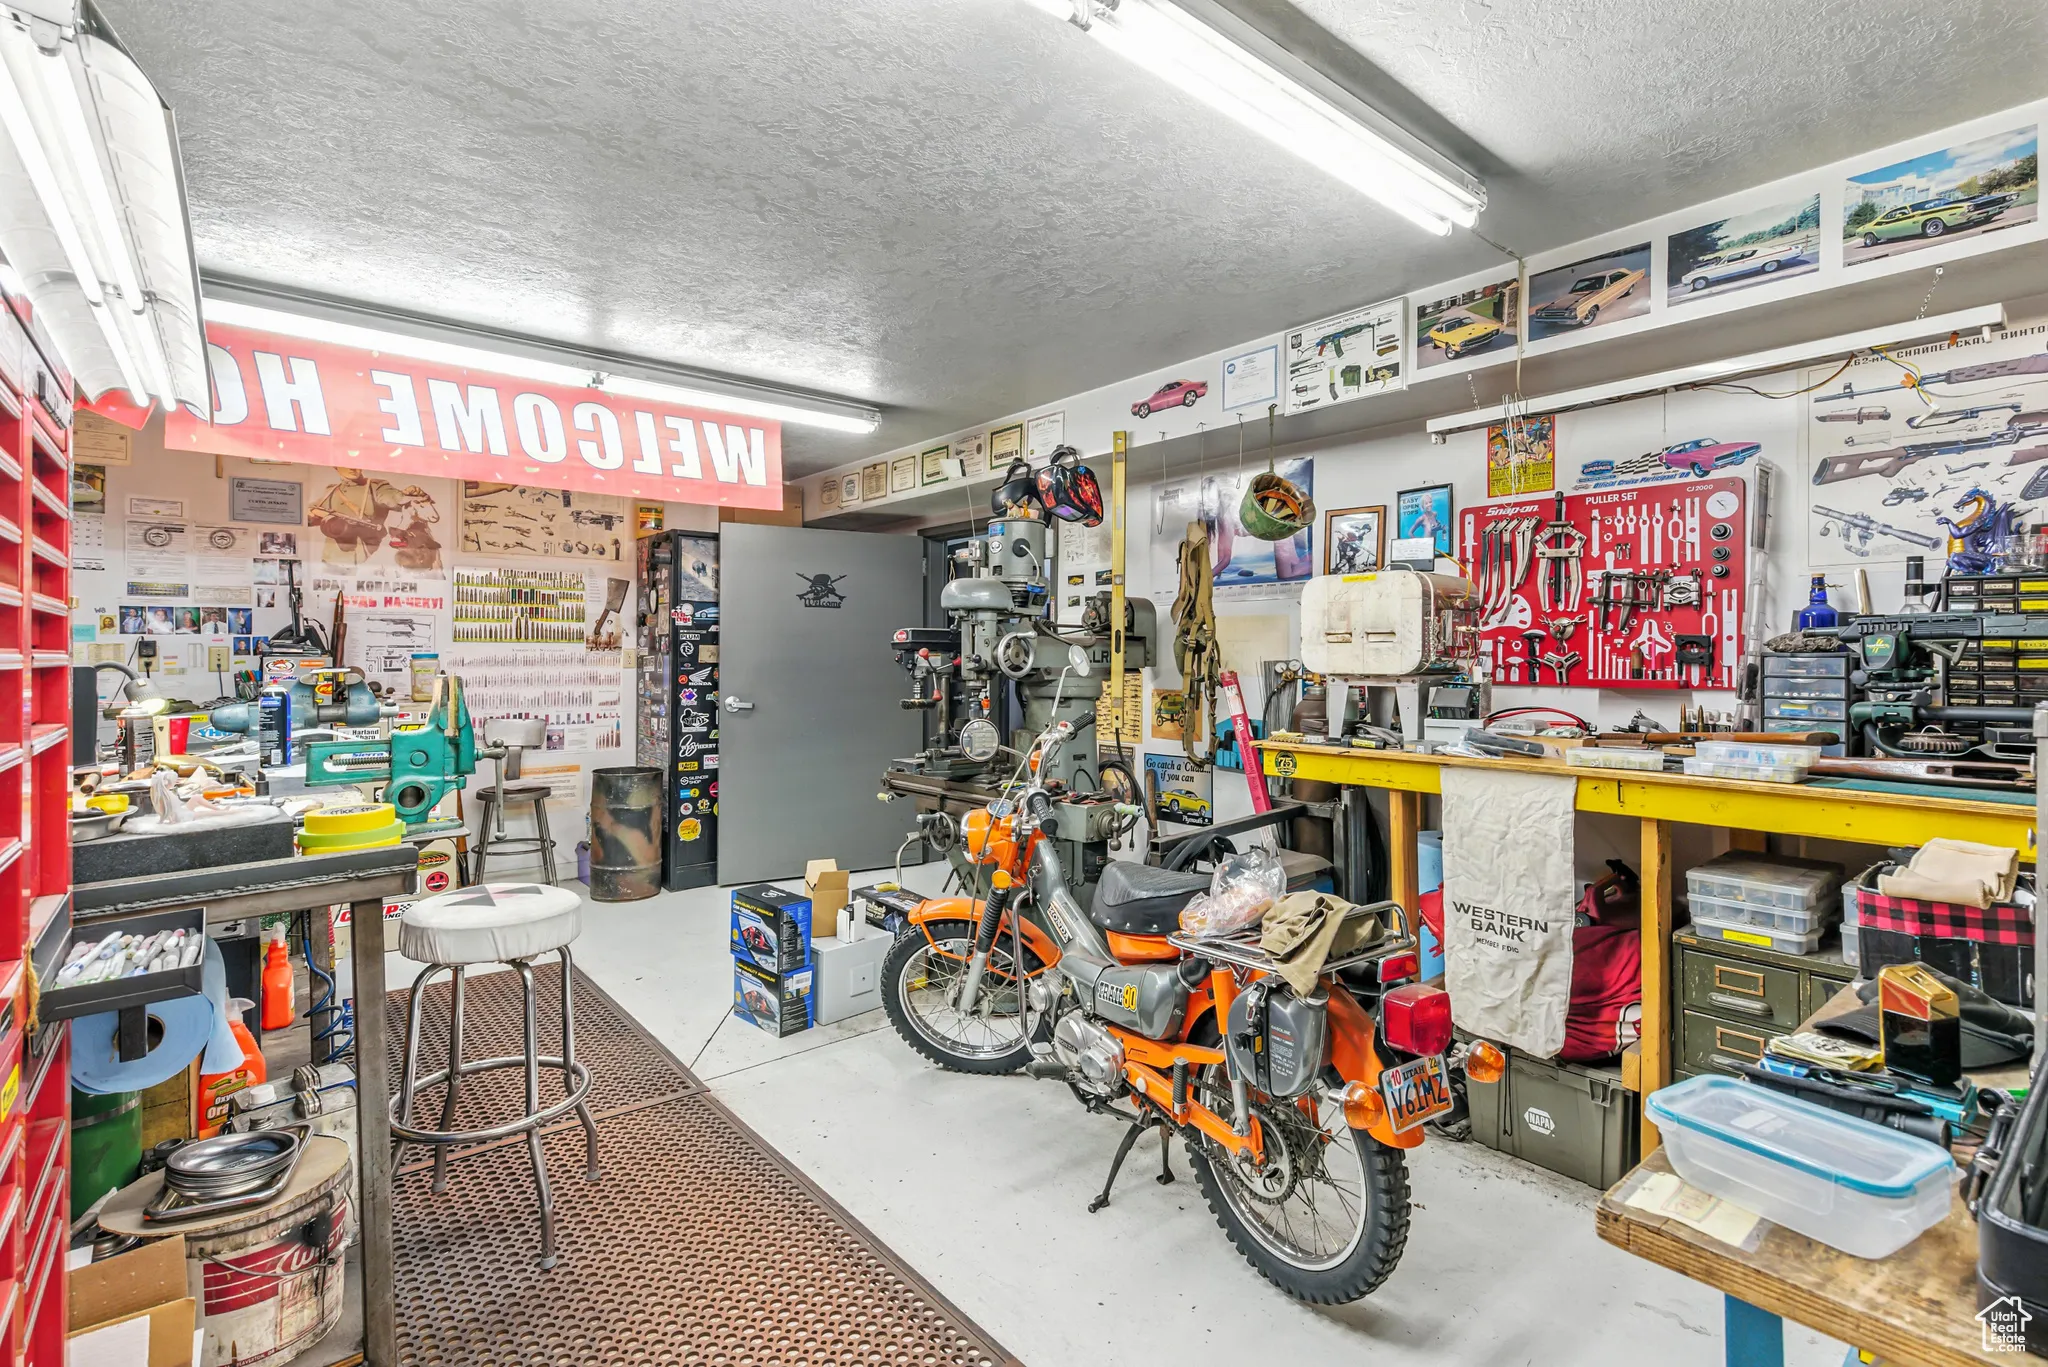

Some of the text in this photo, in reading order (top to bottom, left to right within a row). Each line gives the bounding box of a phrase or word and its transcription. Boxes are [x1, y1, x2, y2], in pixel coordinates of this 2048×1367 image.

[2001, 325, 2048, 340] ВИНТО
[1403, 497, 1418, 505] EASY
[1585, 491, 1638, 505] PULLER SET
[1403, 503, 1419, 511] OPEN
[1486, 505, 1539, 517] Snap-on
[1146, 758, 1157, 768] Go
[1157, 760, 1175, 771] catch
[1278, 757, 1292, 767] 75
[1160, 770, 1194, 783] if you can
[1182, 815, 1203, 824] Plymouth
[1452, 900, 1548, 933] WESTERN
[1048, 906, 1073, 943] HONDA
[1471, 918, 1525, 943] BANK
[1476, 937, 1499, 949] MEMBER
[1098, 980, 1138, 1012] TRAIL 90
[1057, 1038, 1078, 1054] HONDA
[1428, 1056, 1438, 1069] 22
[1390, 1064, 1426, 1087] 10 UTAH
[214, 1094, 234, 1105] Oxy
[1528, 1111, 1551, 1131] NAPA
